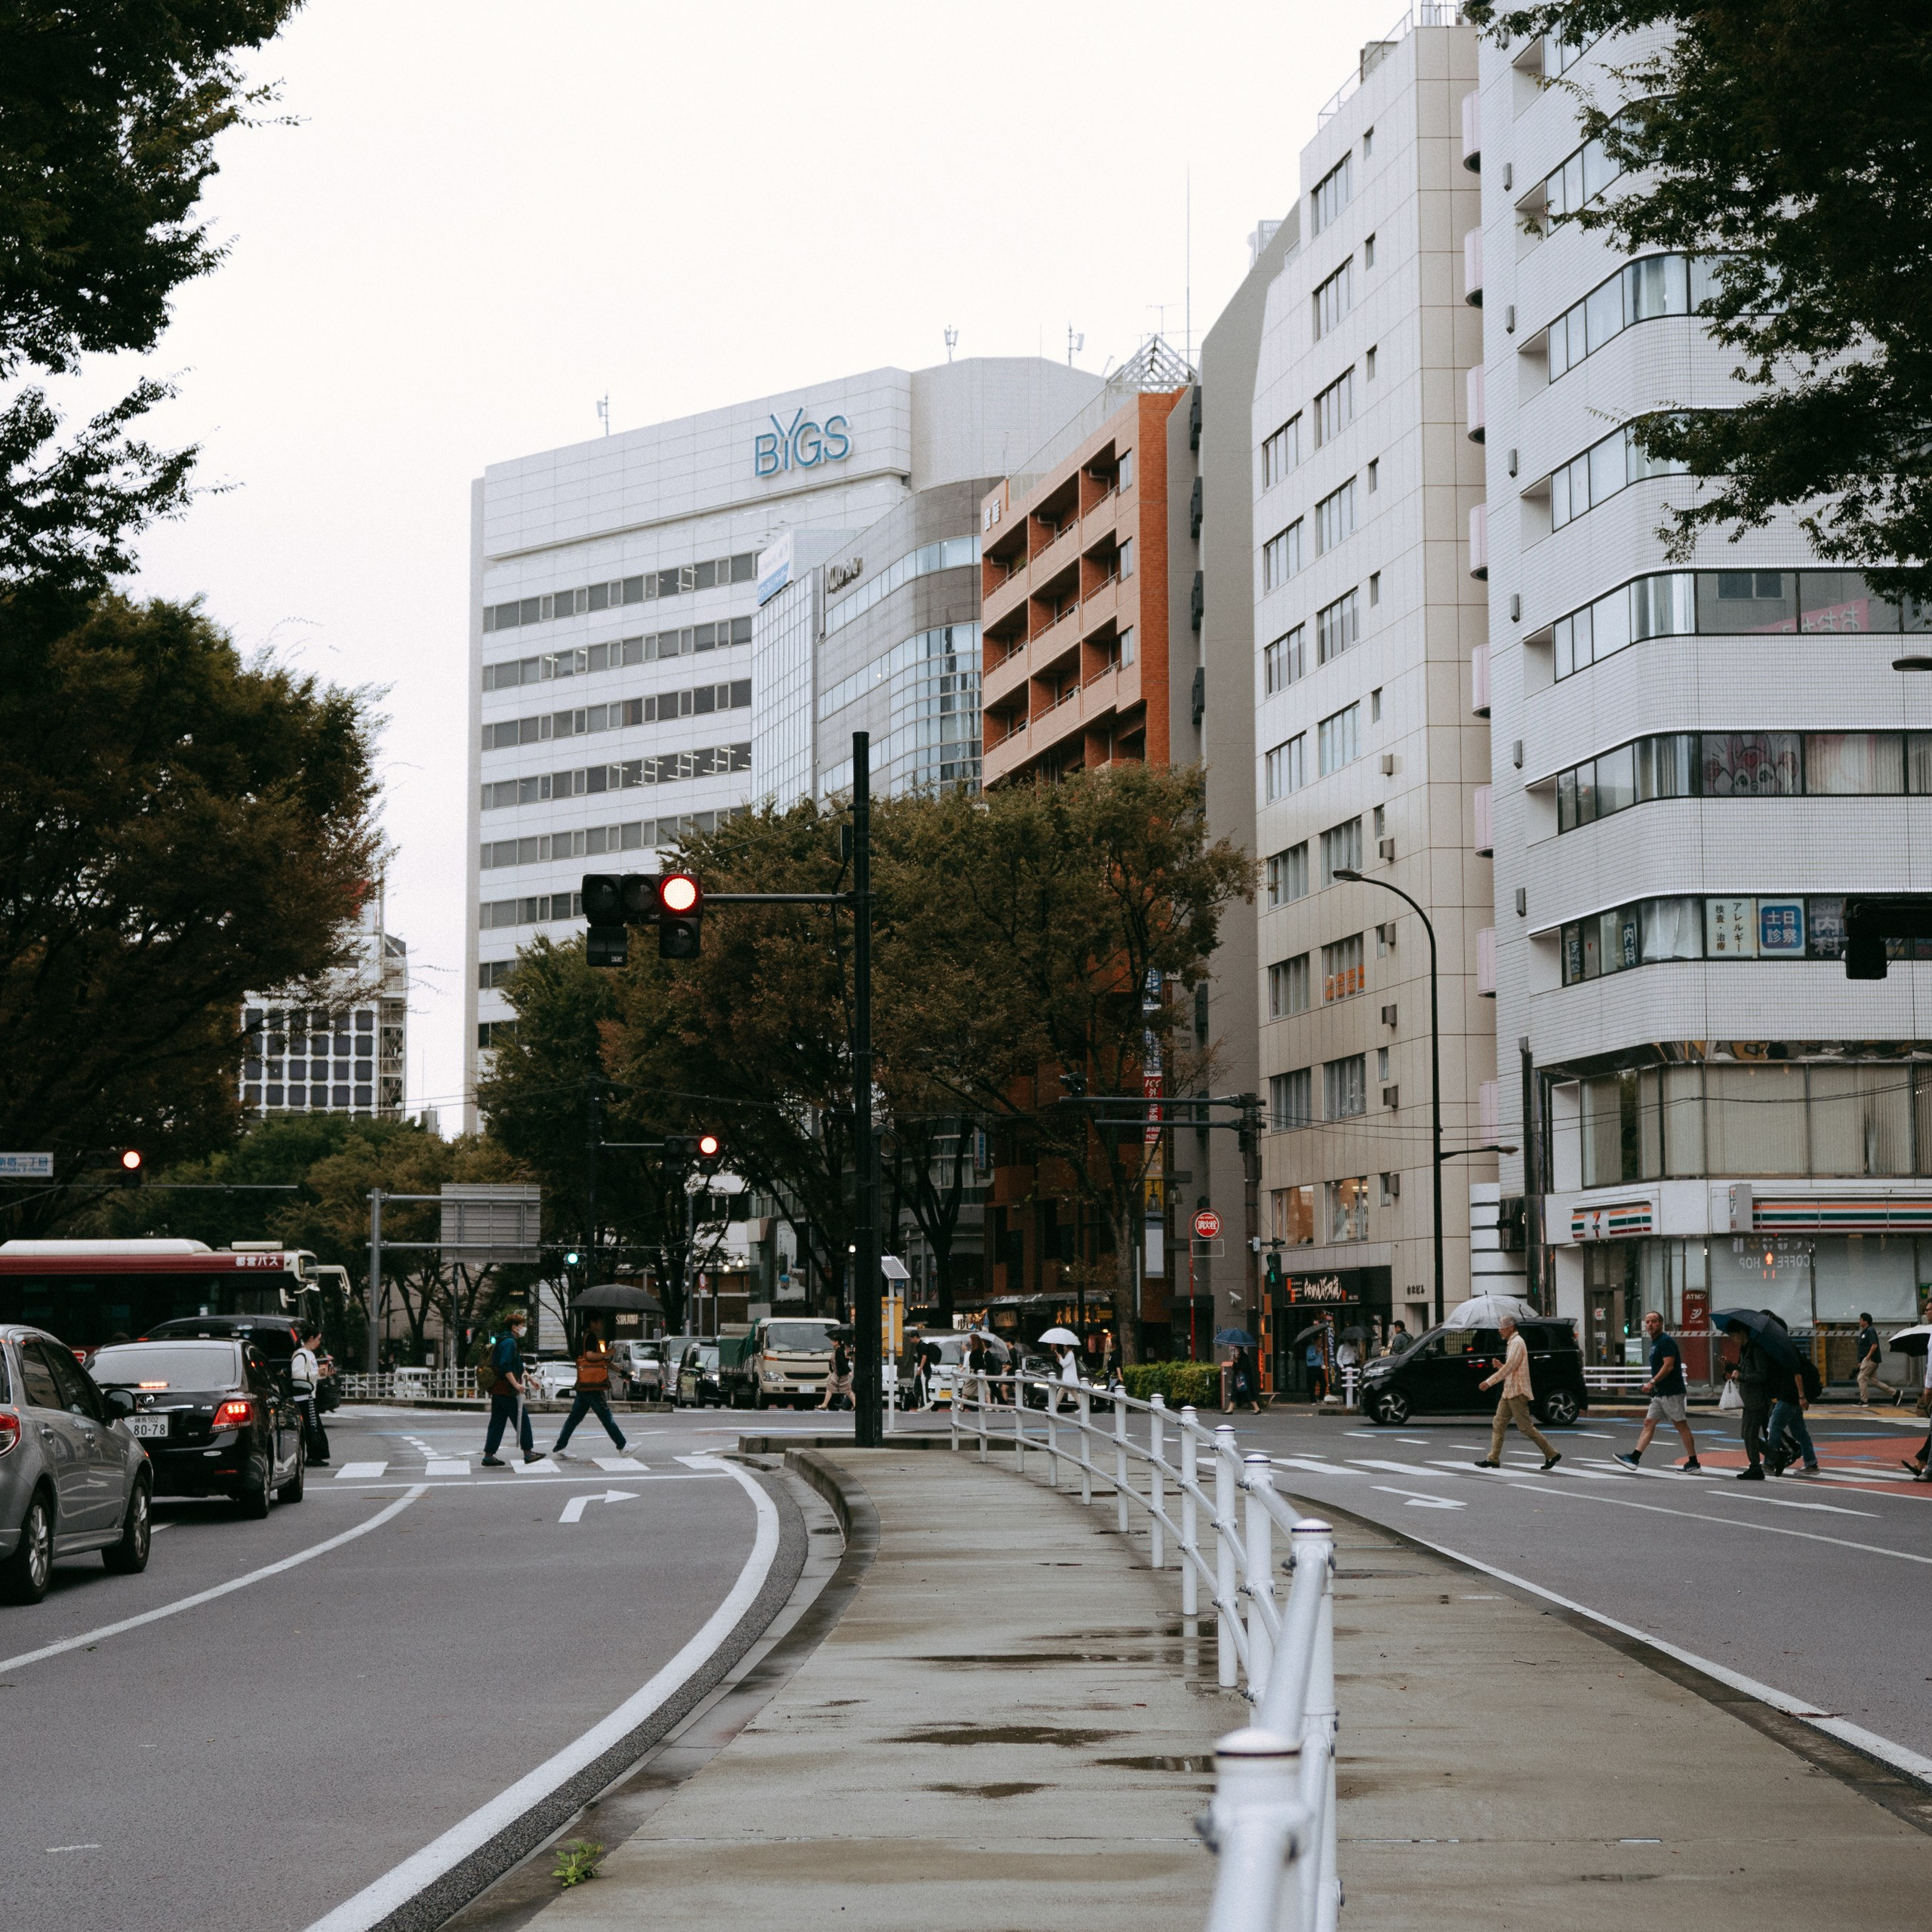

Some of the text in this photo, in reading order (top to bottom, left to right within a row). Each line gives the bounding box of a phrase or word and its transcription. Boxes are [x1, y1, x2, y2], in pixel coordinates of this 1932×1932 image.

[755, 407, 851, 477] BYGS
[1715, 905, 1726, 951] 検査・治療
[1733, 902, 1743, 952] アレルギー
[1767, 911, 1795, 925] 土日
[1623, 926, 1636, 965] 内科
[1767, 929, 1797, 943] 診察
[1814, 916, 1840, 955] 内科
[1198, 1220, 1217, 1230] 消火栓
[235, 1256, 278, 1267] 都営バス
[134, 1423, 165, 1435] 80-78
